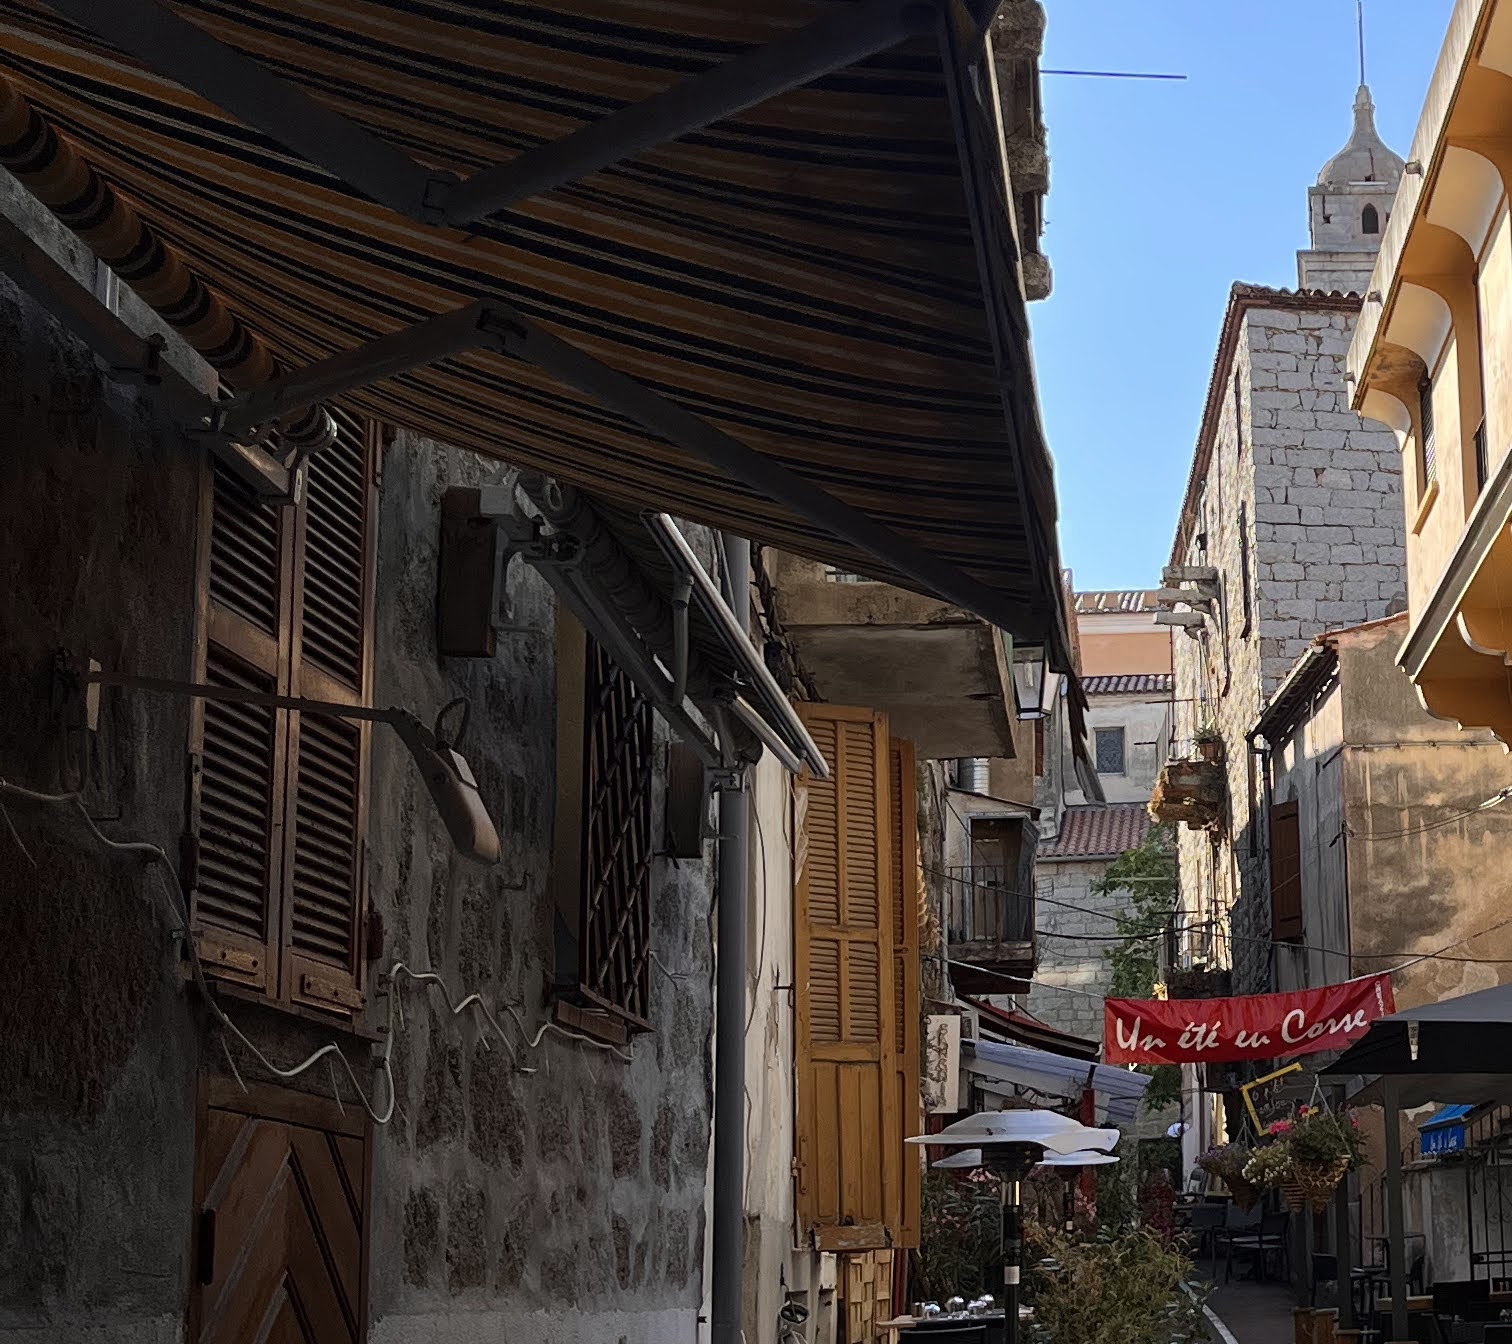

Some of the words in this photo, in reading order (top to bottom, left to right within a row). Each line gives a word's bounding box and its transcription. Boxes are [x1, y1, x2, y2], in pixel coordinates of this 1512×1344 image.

[1116, 1016, 1166, 1052] Un
[1178, 1020, 1221, 1052] été
[1235, 1030, 1270, 1048] en
[1281, 1008, 1368, 1044] Corse
